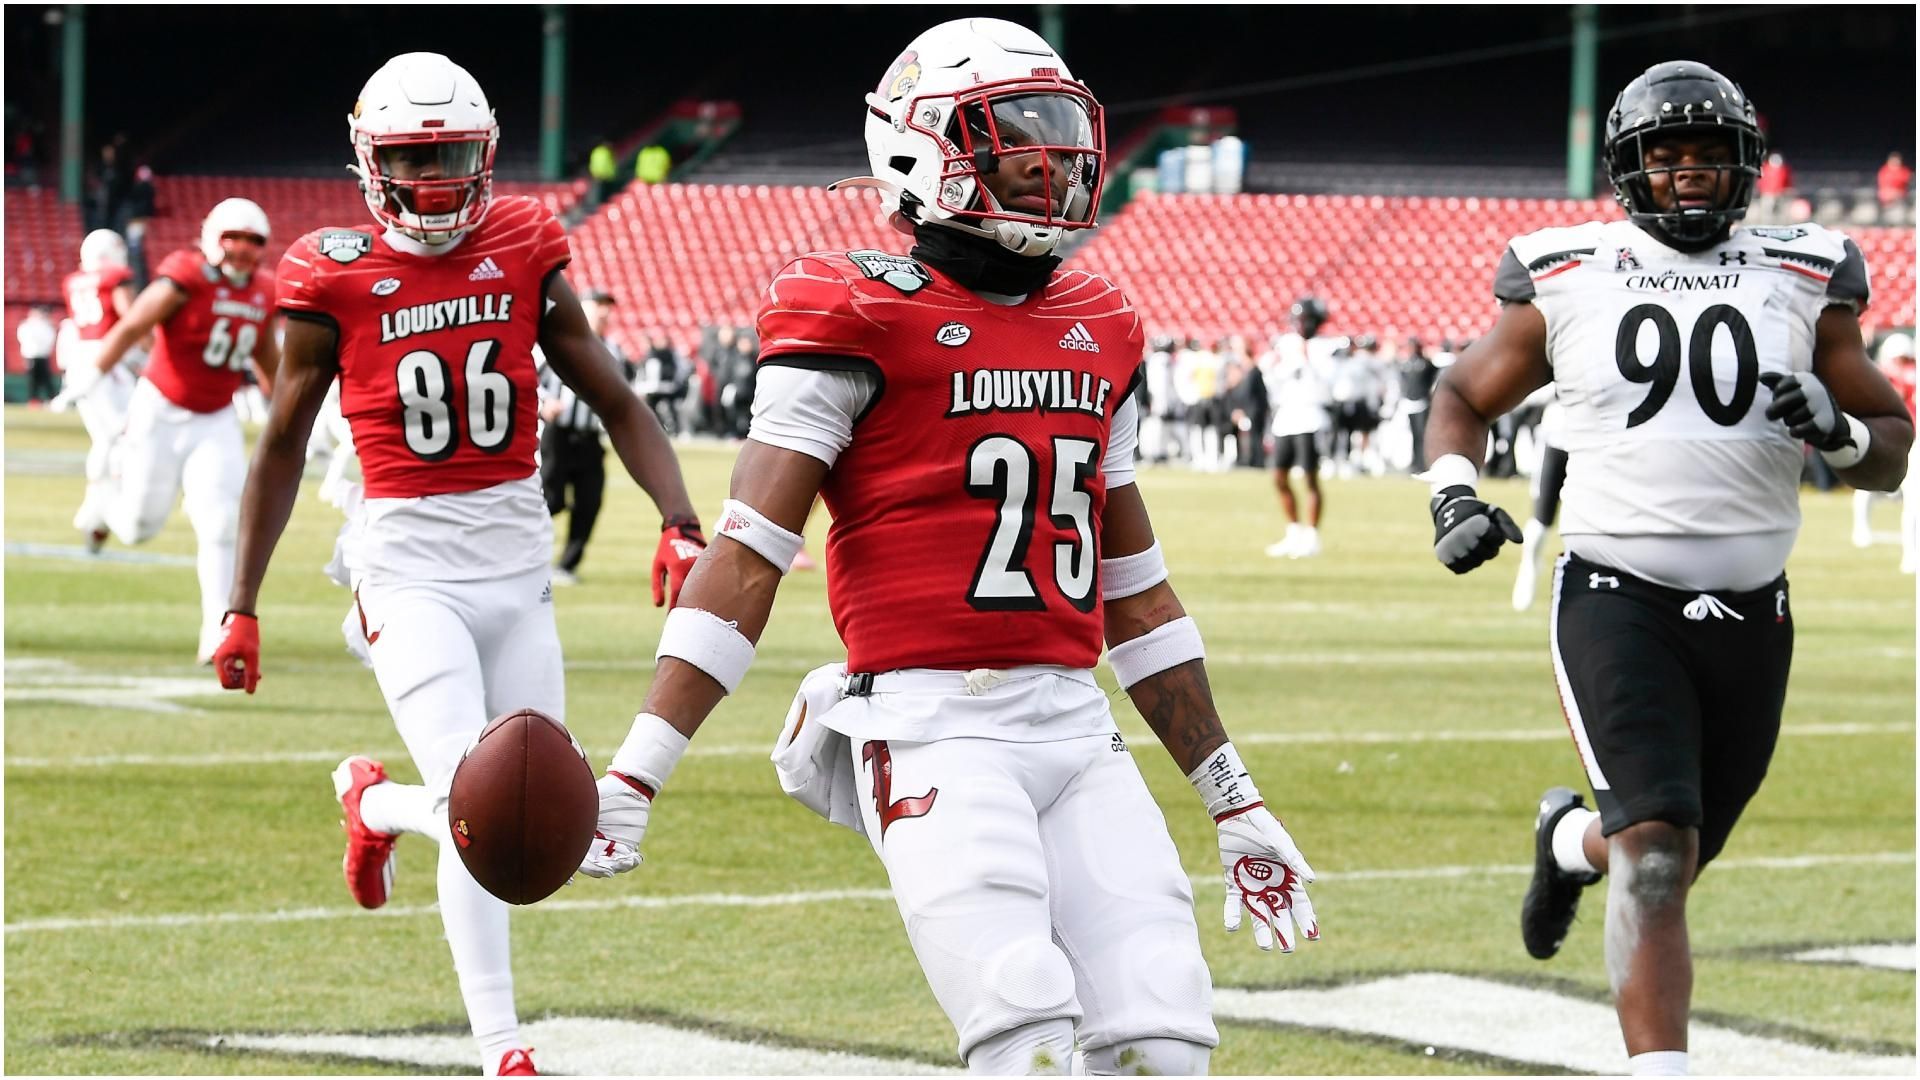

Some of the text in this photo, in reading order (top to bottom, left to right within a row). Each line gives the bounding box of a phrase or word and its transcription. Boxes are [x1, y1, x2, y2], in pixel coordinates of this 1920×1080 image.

[1626, 271, 1740, 292] CINCINNATI
[381, 293, 513, 343] LOUISVILLE
[941, 326, 967, 342] ACC
[1058, 337, 1100, 353] adidas
[1615, 303, 1759, 428] 90
[396, 339, 514, 460] 86
[948, 368, 1112, 418] LOUISVILLE
[966, 434, 1099, 610] 25
